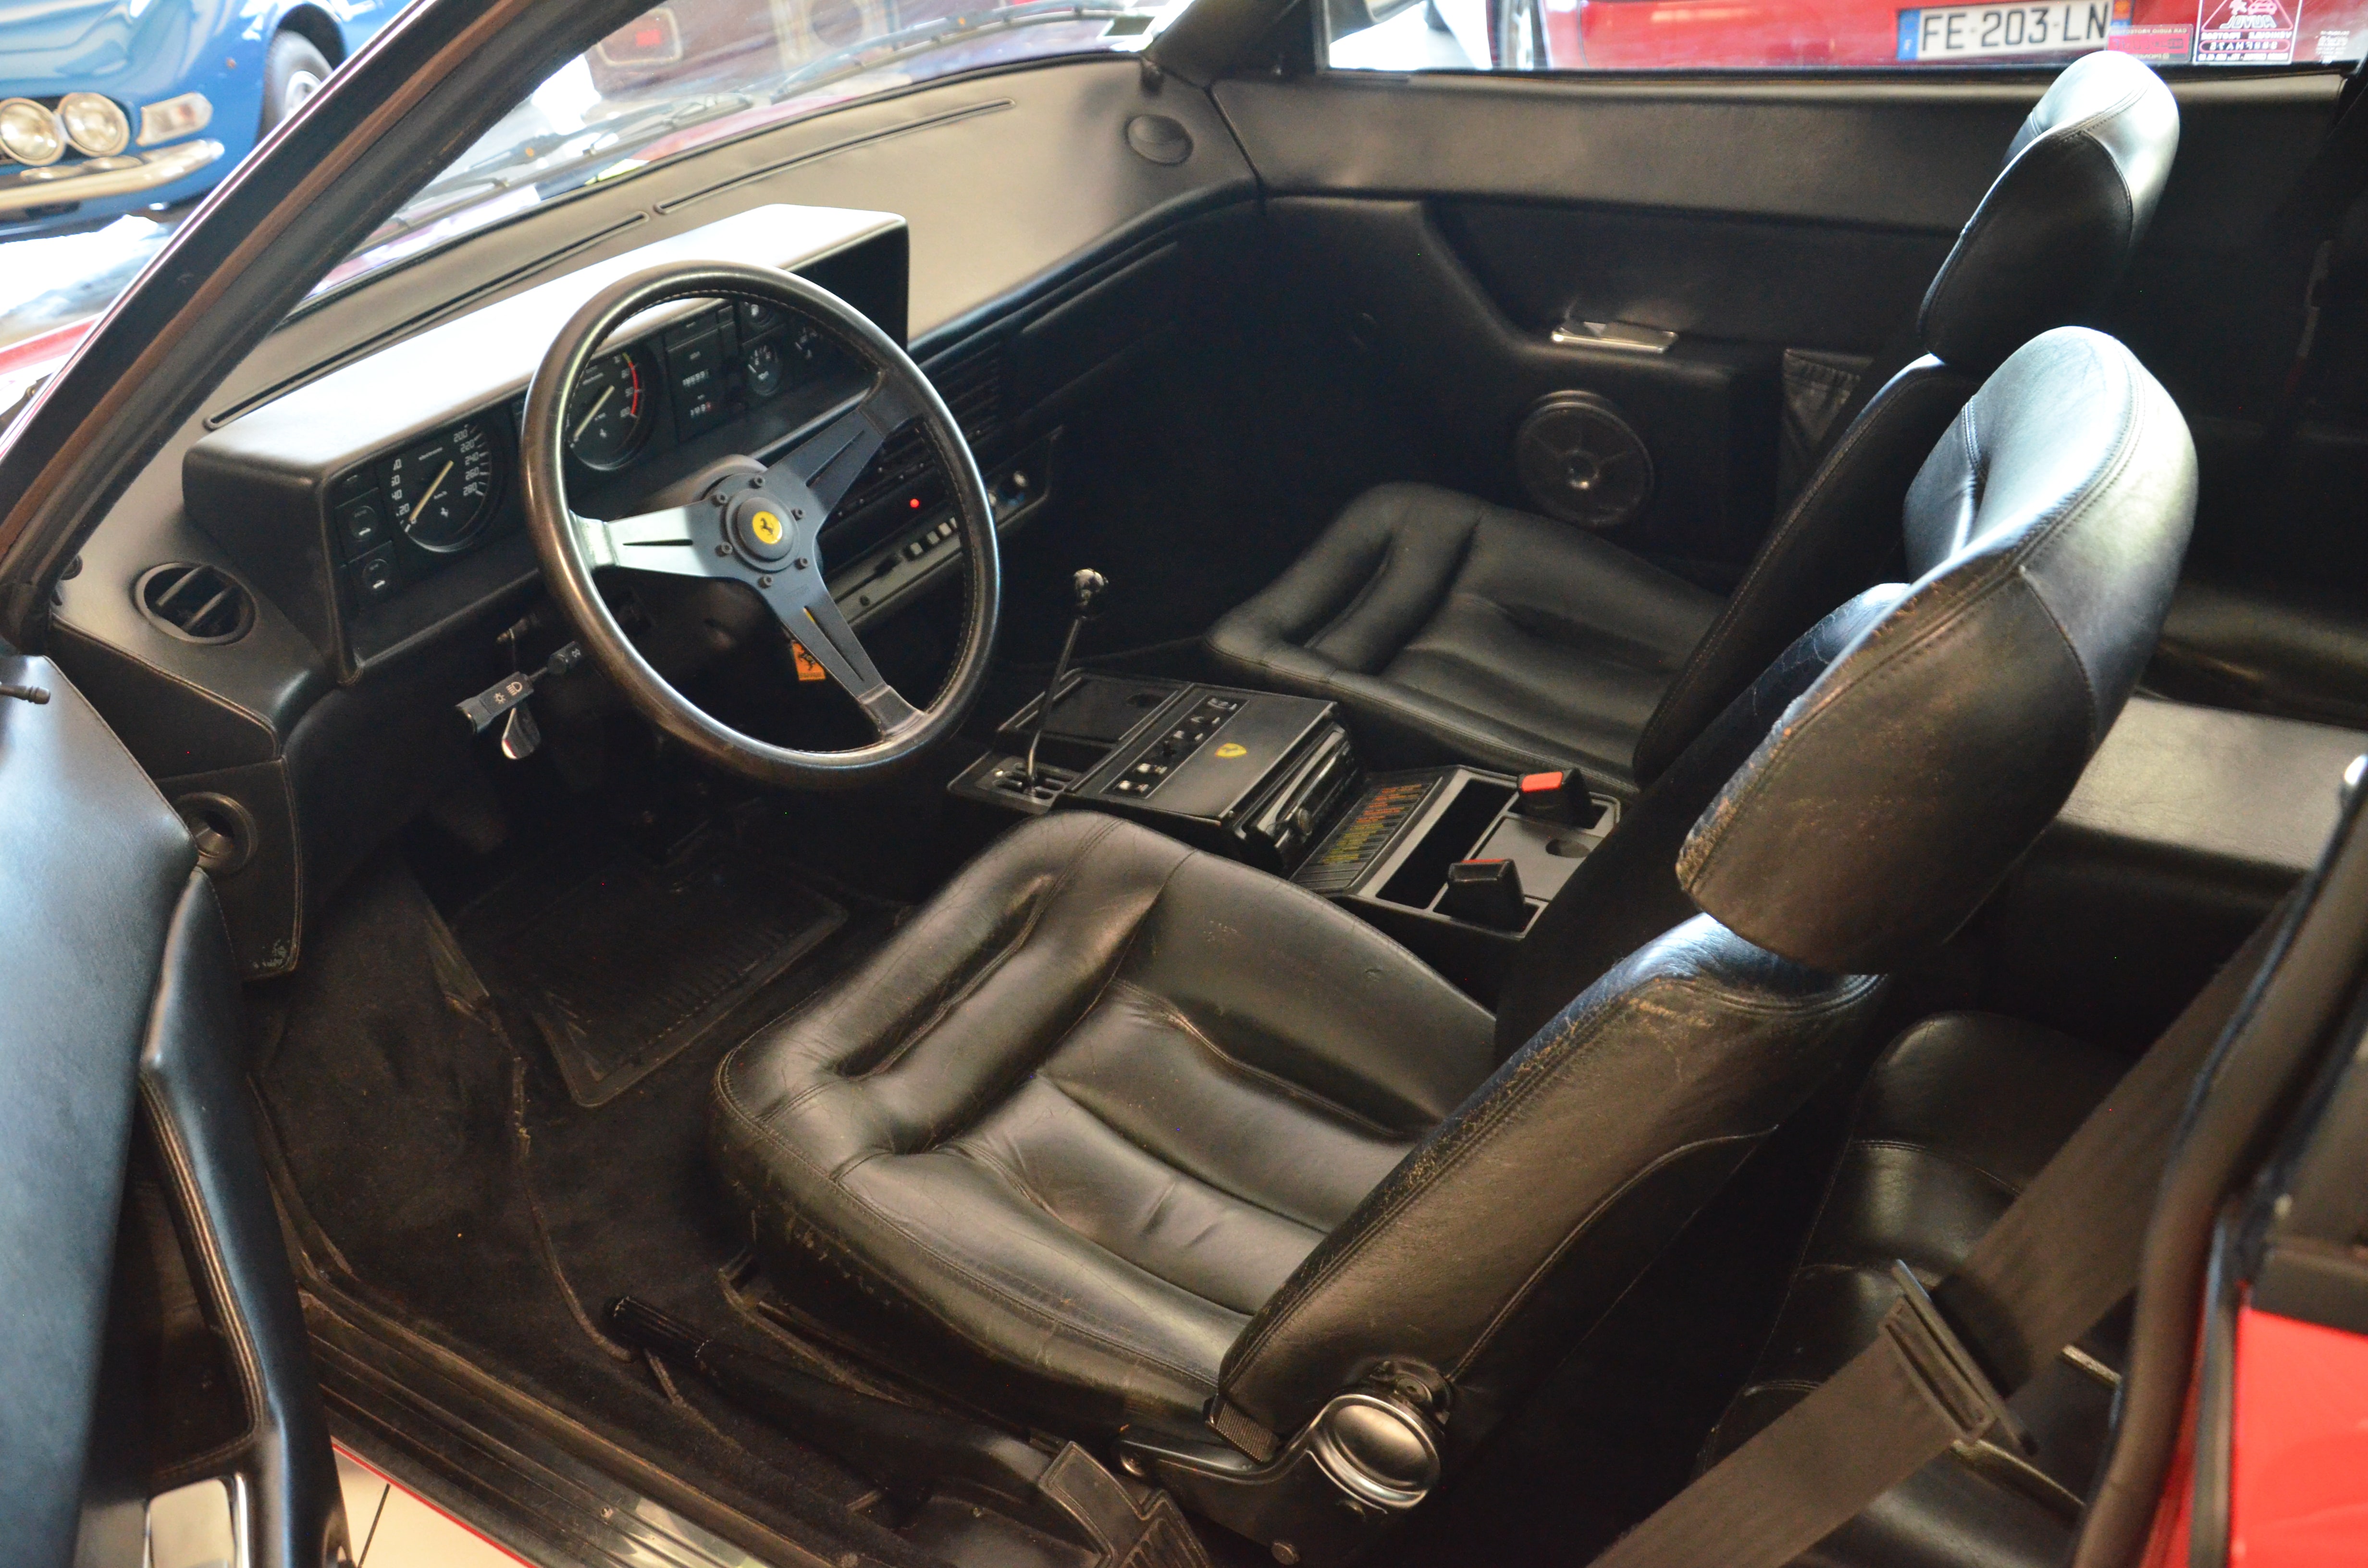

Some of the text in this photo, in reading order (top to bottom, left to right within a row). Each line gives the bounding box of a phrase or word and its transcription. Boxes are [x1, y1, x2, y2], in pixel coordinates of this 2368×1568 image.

[453, 429, 469, 442] 200
[460, 439, 475, 453] 220
[465, 452, 480, 466] 240
[465, 466, 480, 480] 260
[391, 489, 403, 501] 40
[463, 482, 478, 496] 280
[398, 502, 410, 516] 20
